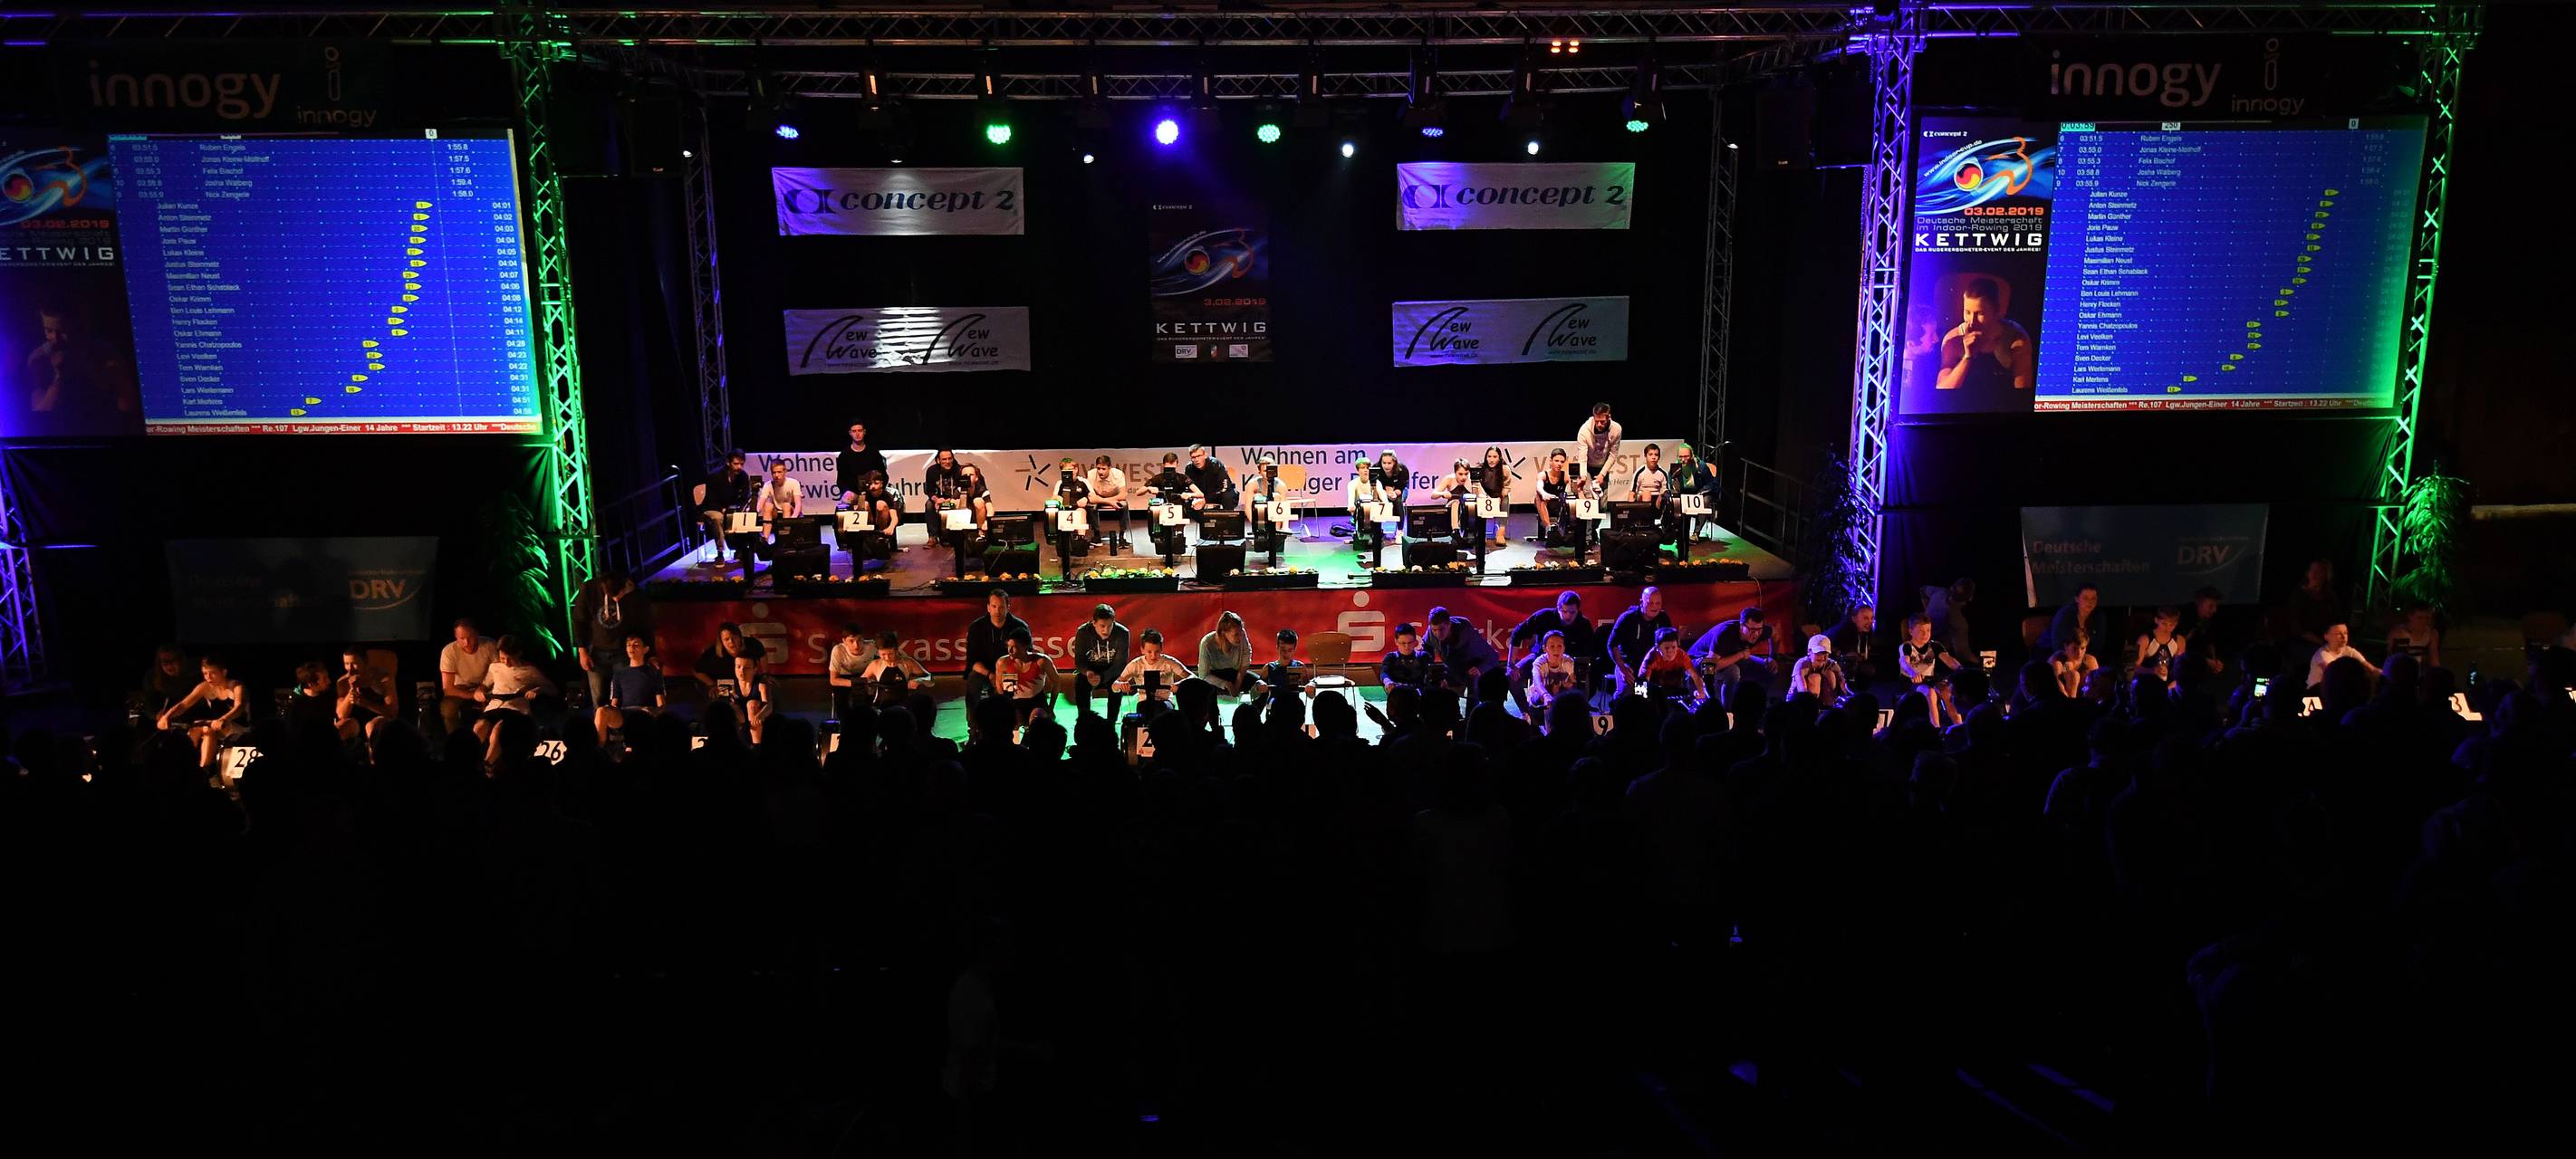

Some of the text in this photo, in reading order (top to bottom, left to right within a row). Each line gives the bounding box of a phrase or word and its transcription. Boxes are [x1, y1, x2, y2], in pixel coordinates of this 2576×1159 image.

[2051, 50, 2222, 107] innogy
[90, 59, 282, 120] innogy
[2231, 95, 2305, 115] innogy
[297, 106, 378, 128] innogy
[840, 189, 1014, 213] concept 2
[1456, 185, 1624, 207] concept 2
[1964, 207, 2044, 216] 03.02.2019
[1918, 216, 2043, 225] Deutsche Meisterschaft
[1933, 224, 2009, 233] Indoor-Rowing
[1915, 233, 2043, 246] KETTWIG
[1156, 321, 1267, 334] KETTWIG
[1429, 334, 1479, 350] Wave
[1548, 331, 1597, 347] Wave
[826, 342, 877, 359] Wave
[947, 343, 998, 359] Wave
[187, 424, 250, 432] Meisterschaften
[758, 454, 838, 472] Wohne
[1241, 447, 1366, 465] Wohnen am
[1275, 503, 1283, 515] 6
[1379, 503, 1386, 515] 7
[1485, 500, 1493, 512] 8
[1583, 500, 1591, 512] 9
[1687, 496, 1701, 509] 10
[852, 512, 860, 524] 2
[1066, 512, 1073, 524] 4
[1168, 507, 1175, 519] 5
[2033, 540, 2101, 554] Deutsche
[2177, 545, 2229, 564] DRV
[351, 580, 406, 599] DRV
[234, 748, 259, 768] 28
